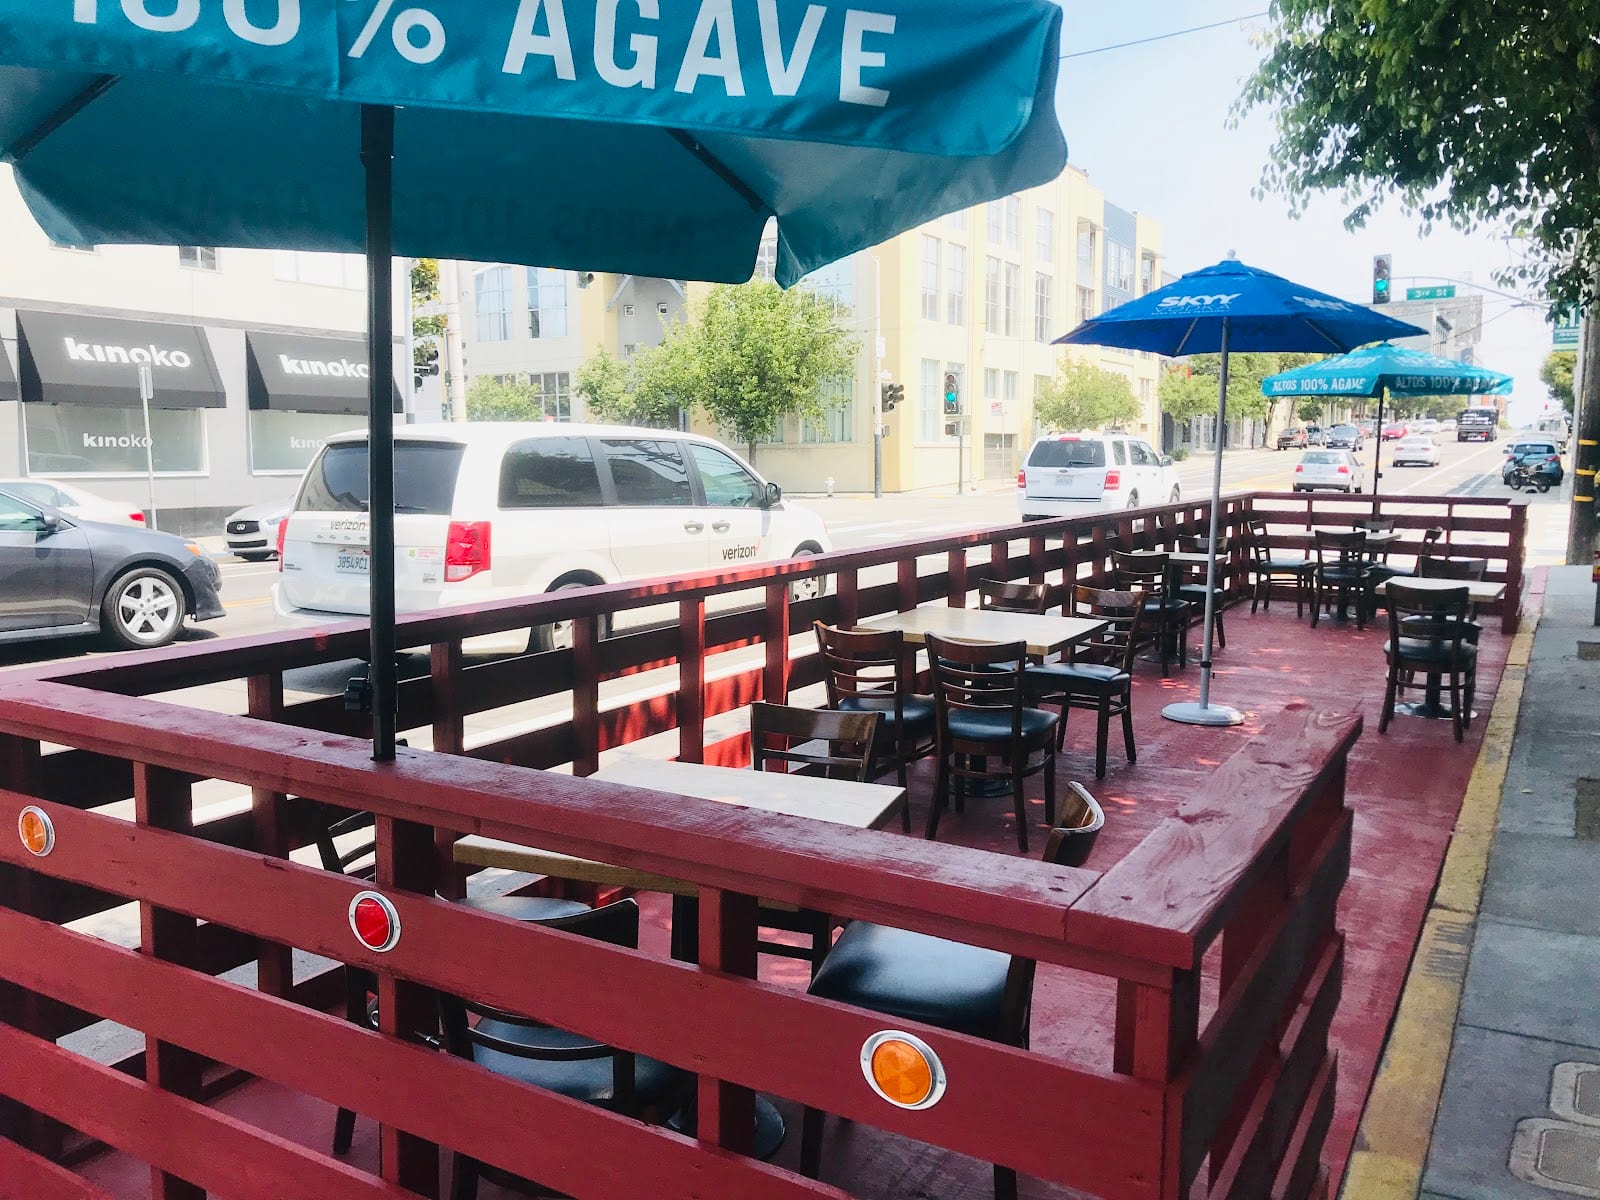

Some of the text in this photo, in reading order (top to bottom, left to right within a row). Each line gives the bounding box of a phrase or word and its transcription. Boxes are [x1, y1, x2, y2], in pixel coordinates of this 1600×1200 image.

[73, 0, 897, 107] 0% AGAVE
[1157, 293, 1243, 307] SKYY
[65, 337, 191, 368] kinoko
[1272, 377, 1367, 392] ALTOS 100% AGAVE
[1395, 376, 1426, 389] ALTOS
[1430, 376, 1461, 389] 100%
[83, 433, 153, 448] kinoko
[290, 436, 327, 449] kino
[330, 519, 366, 530] verizon
[722, 544, 756, 560] verizon
